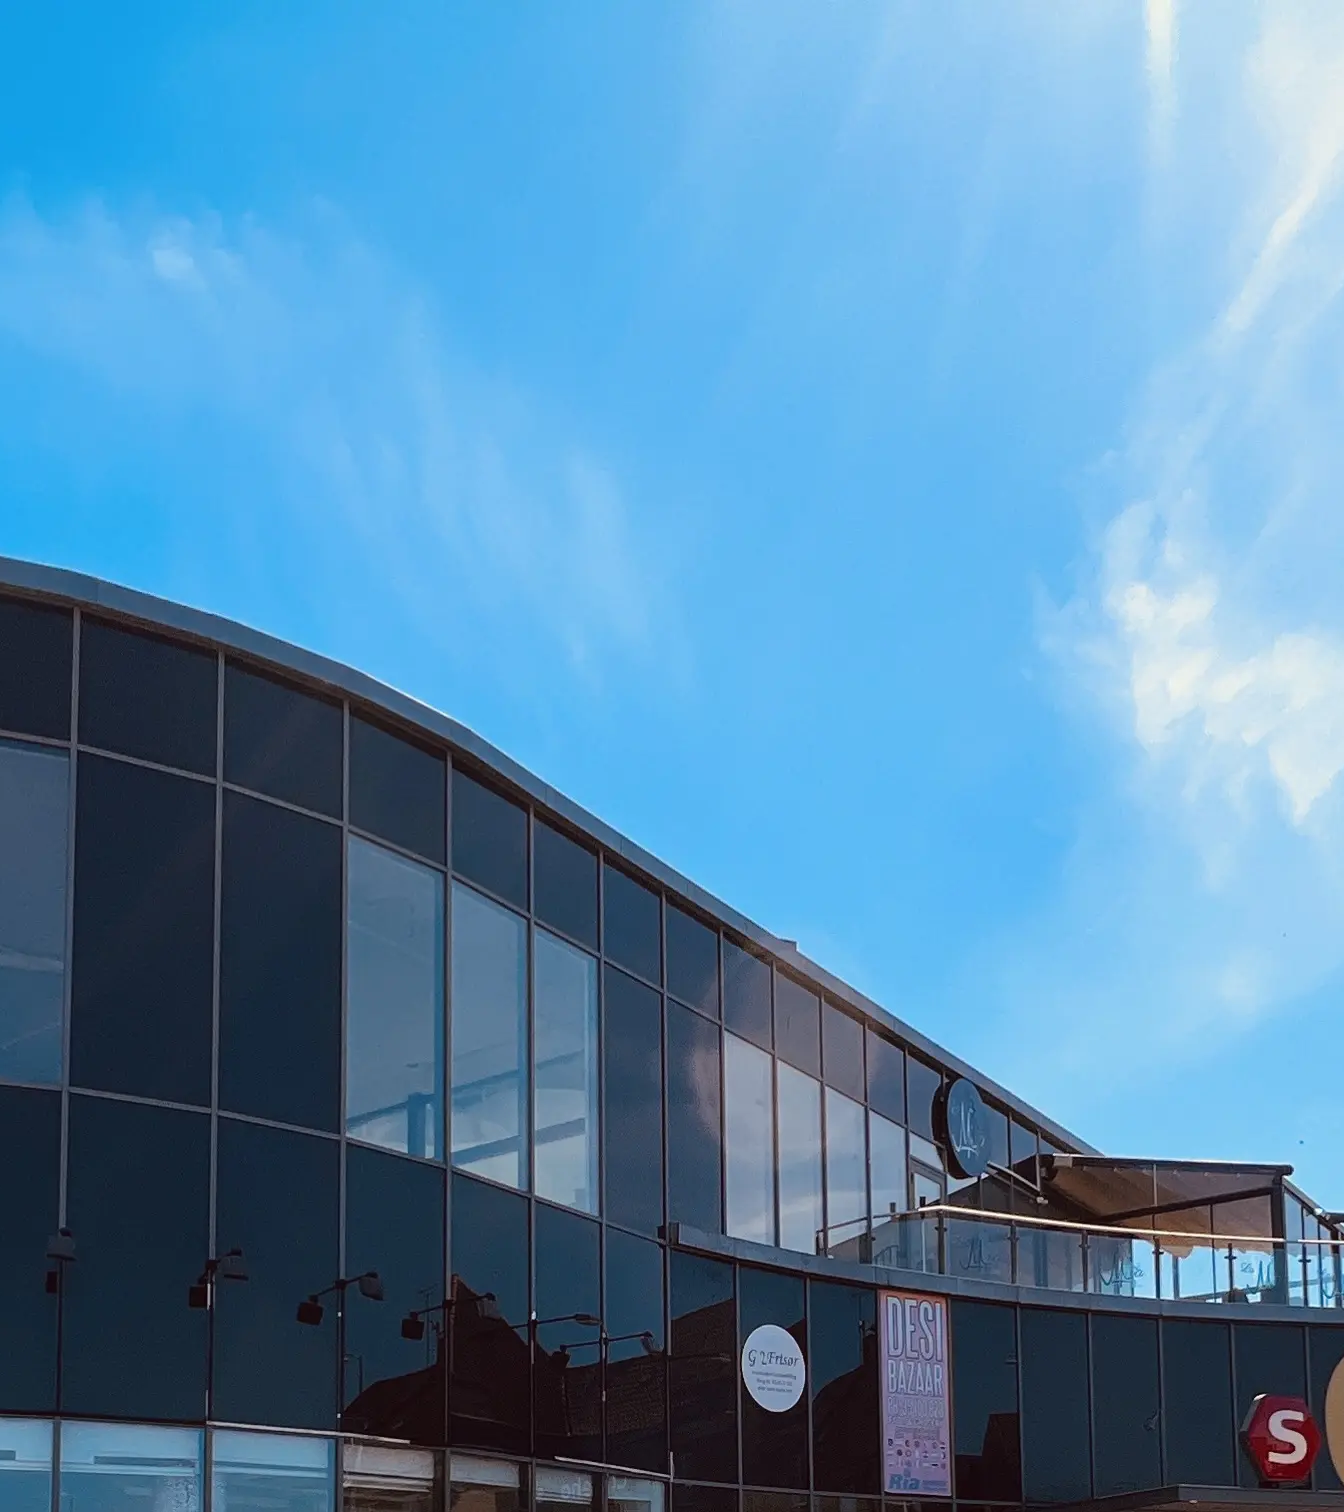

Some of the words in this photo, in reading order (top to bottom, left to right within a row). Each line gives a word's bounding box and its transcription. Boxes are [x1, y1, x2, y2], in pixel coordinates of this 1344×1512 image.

[886, 1296, 943, 1362] DESI
[887, 1359, 944, 1397] BAZAAR
[1267, 1409, 1308, 1465] S
